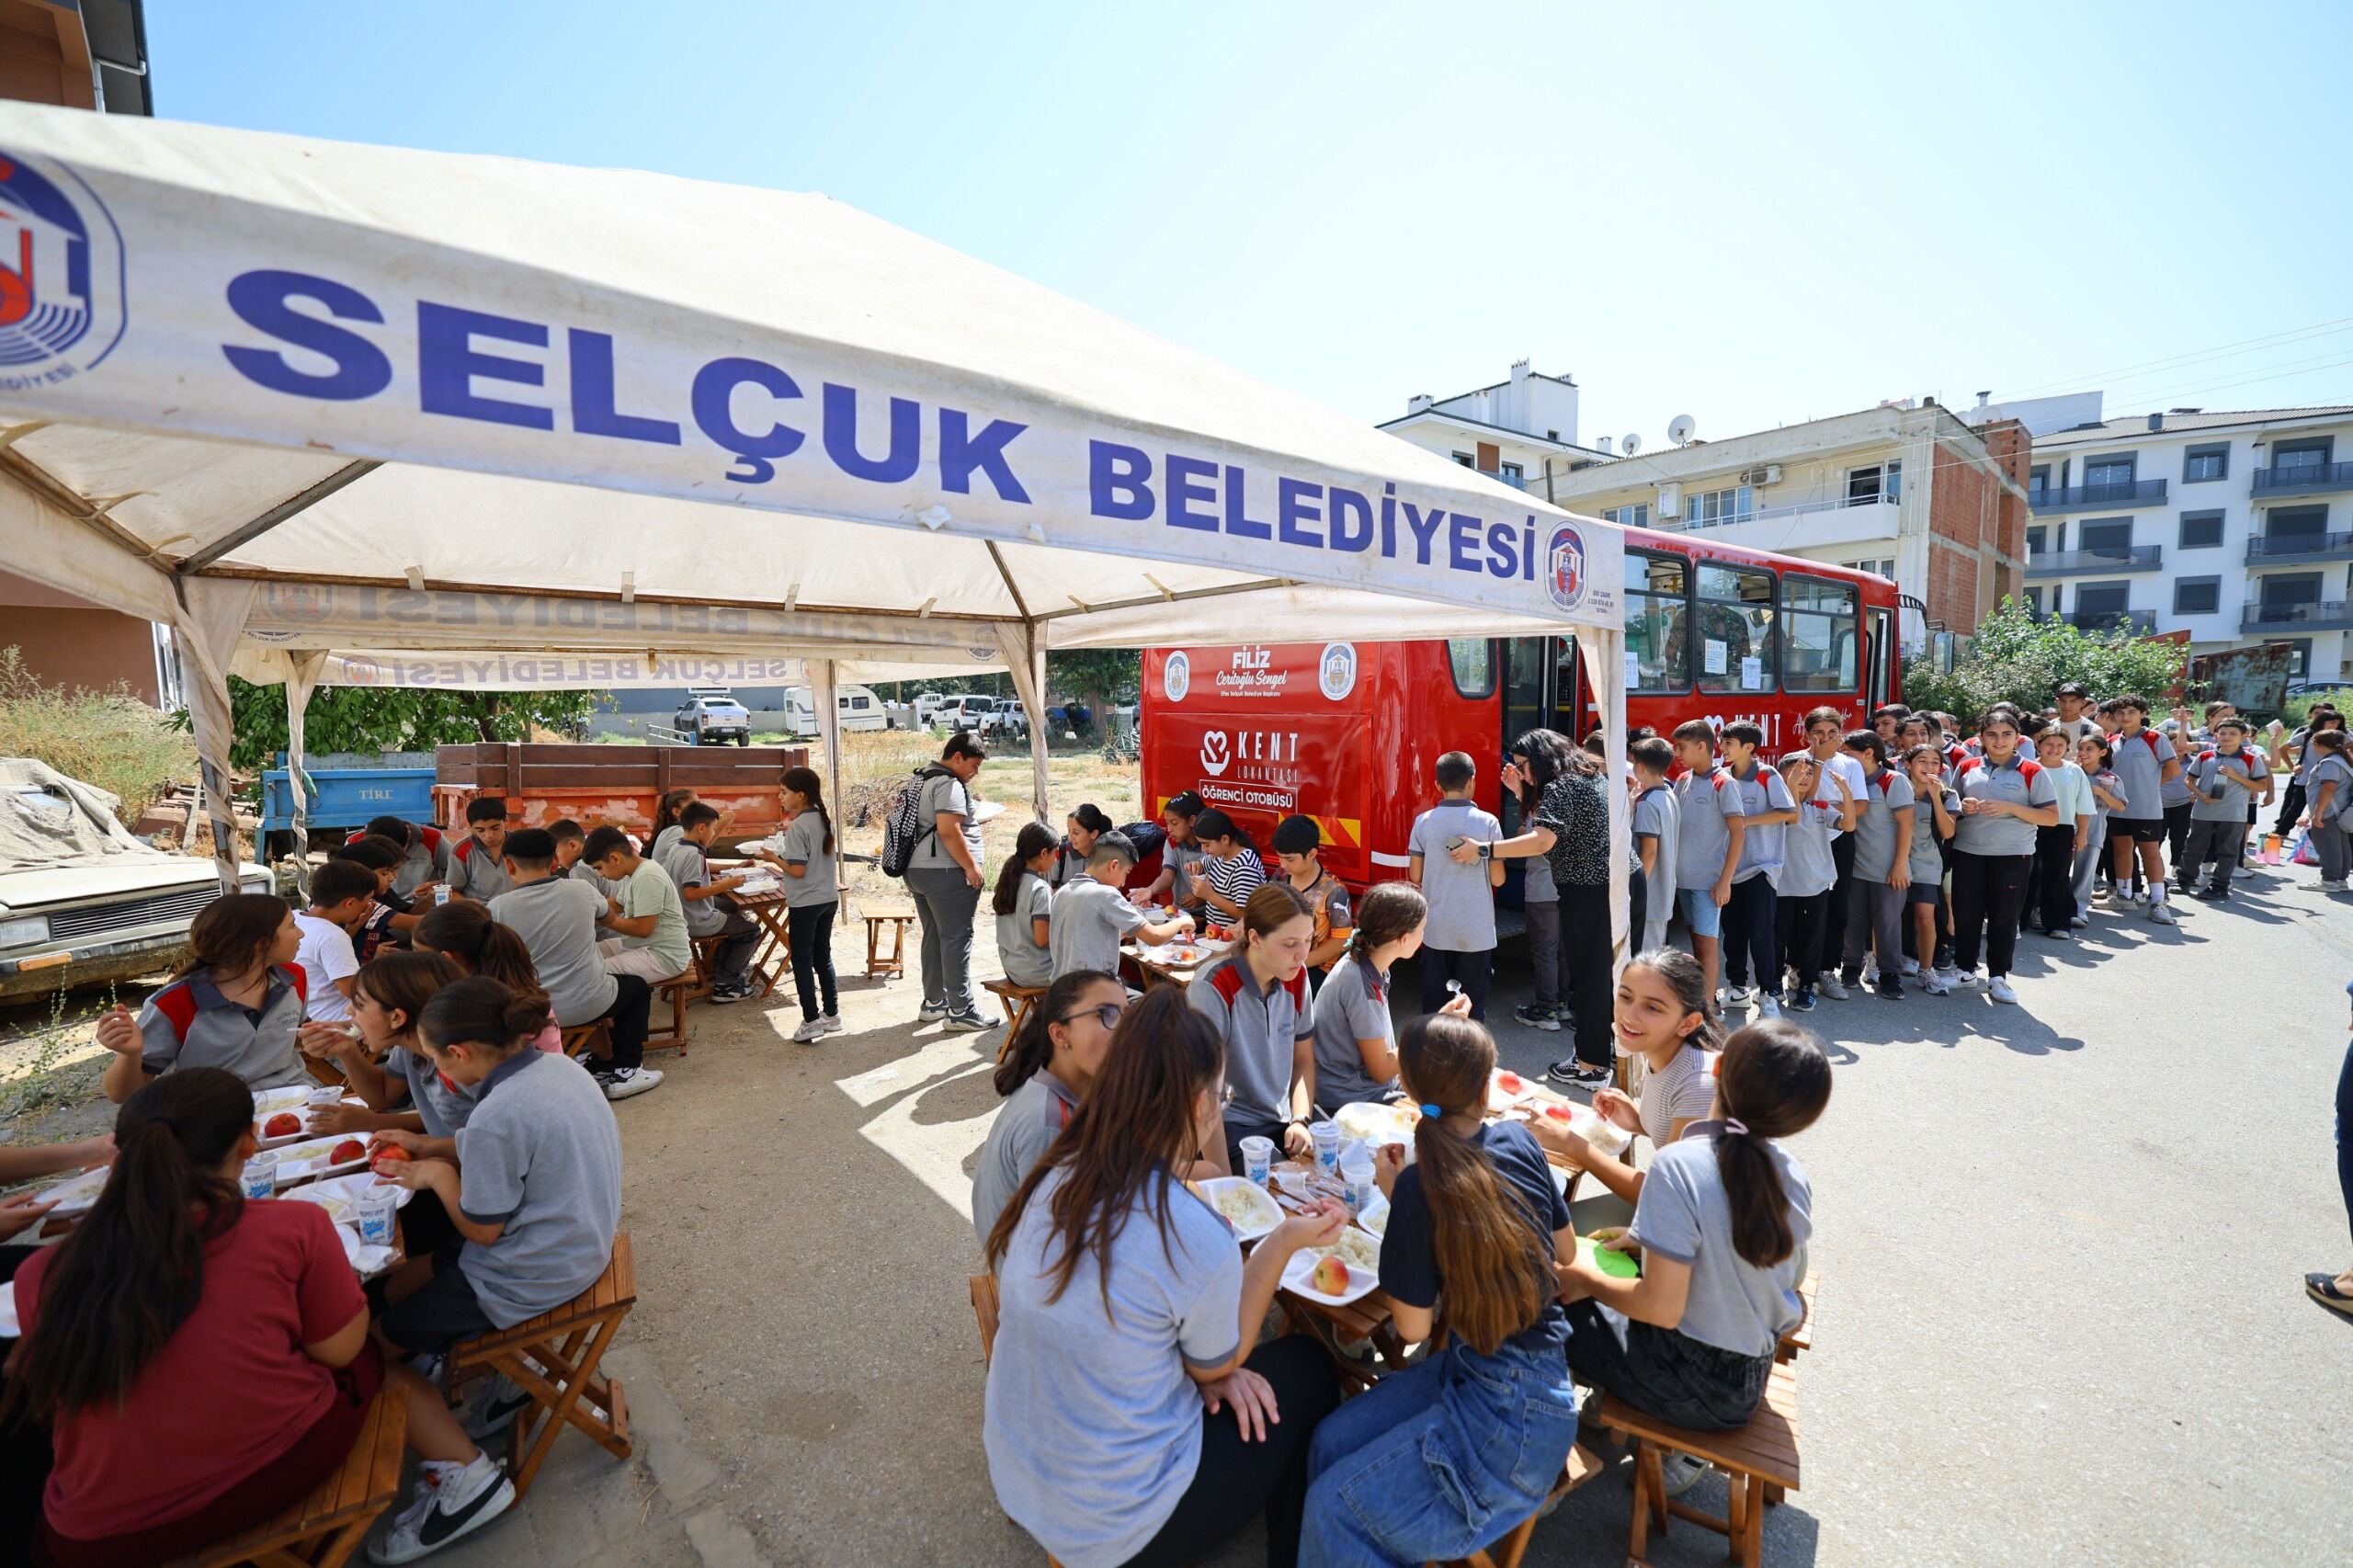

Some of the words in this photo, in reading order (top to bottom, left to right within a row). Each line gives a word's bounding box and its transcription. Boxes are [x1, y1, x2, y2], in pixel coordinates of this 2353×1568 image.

[222, 268, 1031, 505] SELÇUK
[1090, 438, 1536, 581] BELEDİYESİ
[1233, 645, 1270, 669] FİLİZ
[1216, 670, 1254, 689] Ceritoğlu
[1238, 732, 1298, 761] KENT
[1237, 765, 1297, 784] LOKANTASI
[358, 788, 393, 800] TİRE
[1202, 784, 1244, 802] ÖĞRENCİ
[1246, 791, 1292, 808] OTOBÜSÜ
